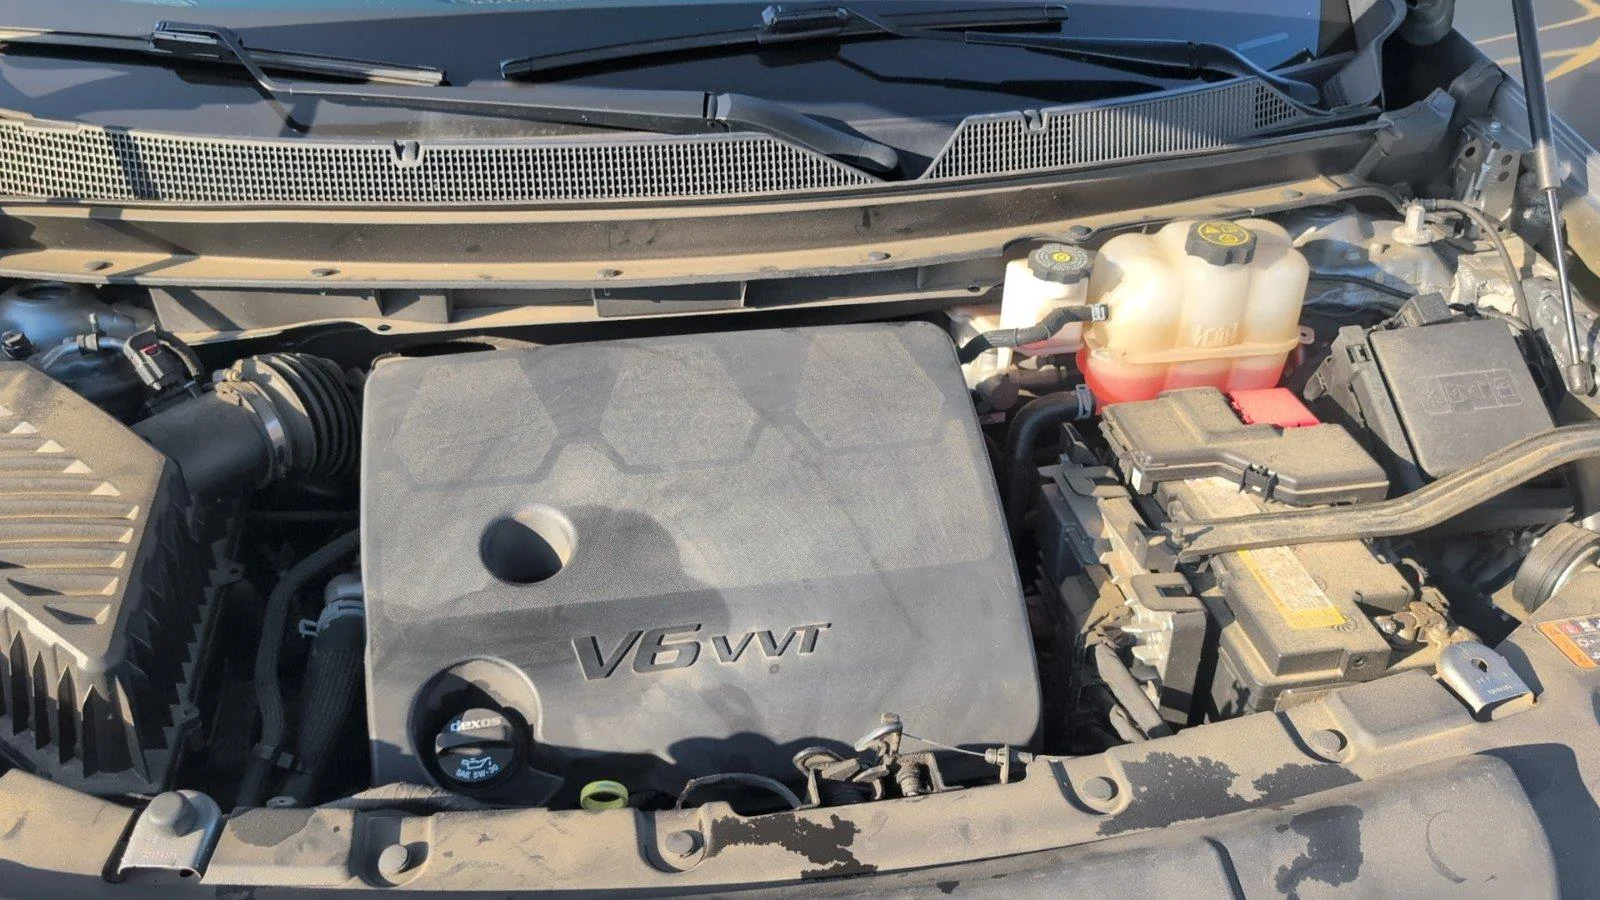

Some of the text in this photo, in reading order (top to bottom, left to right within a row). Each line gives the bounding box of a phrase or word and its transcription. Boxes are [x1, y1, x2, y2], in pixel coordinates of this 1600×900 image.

[572, 622, 832, 681] V6 VVT
[450, 716, 502, 731] dexos
[455, 764, 499, 778] SAE 5W-30
